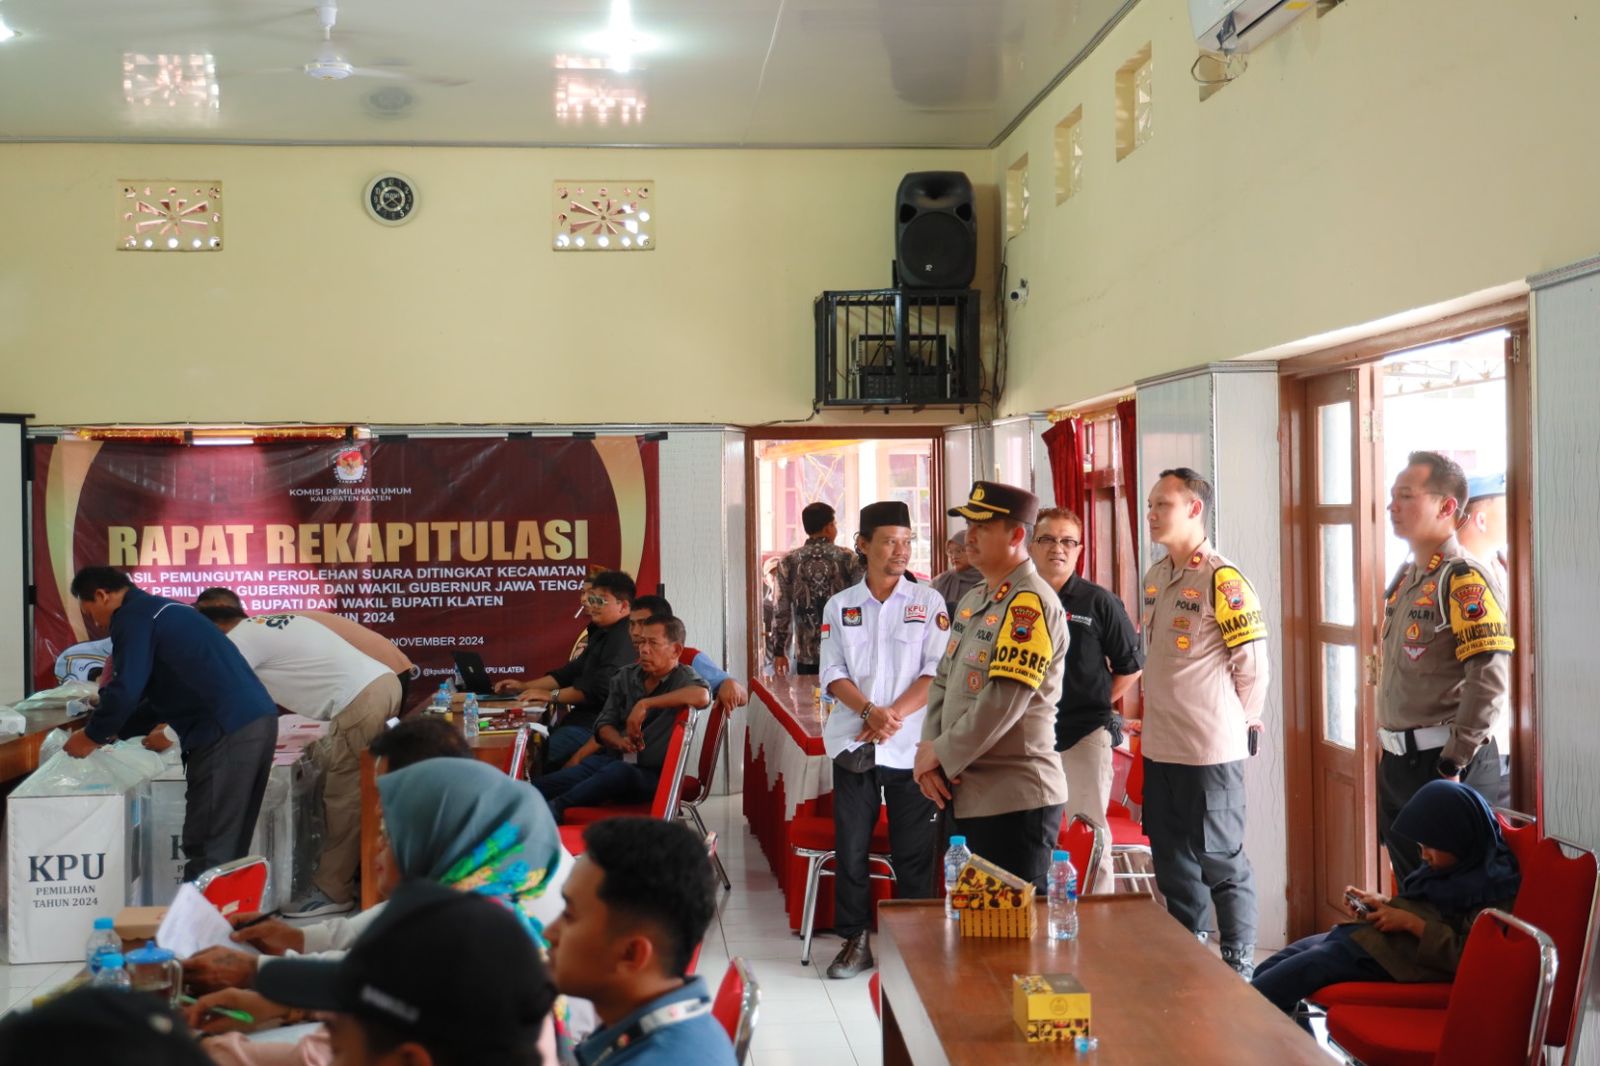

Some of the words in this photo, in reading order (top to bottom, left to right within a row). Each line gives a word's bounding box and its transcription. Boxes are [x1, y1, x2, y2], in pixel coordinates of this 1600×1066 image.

[289, 488, 323, 496] KOMISI
[107, 524, 254, 567] RAPAT
[267, 520, 588, 565] REKAPITULASI
[160, 571, 264, 583] PEMUNGUTAN
[268, 570, 358, 582] PEROLEHAN
[362, 568, 414, 580] SUARA
[417, 566, 494, 579] DITINGKAT
[498, 565, 586, 578] KECAMATAN
[239, 584, 320, 596] GUBERNUR
[324, 583, 354, 595] DAN
[359, 582, 406, 594] WAKIL
[408, 580, 492, 593] GUBERNUR
[496, 580, 536, 592] JAWA
[540, 579, 586, 592] TENGA
[252, 600, 302, 611] BUPATI
[306, 599, 338, 610] DAN
[342, 598, 388, 609] WAKIL
[392, 596, 442, 608] BUPATI
[448, 596, 504, 607] KLATEN
[1175, 600, 1200, 612] POLRI
[363, 612, 395, 624] 2024
[1408, 610, 1434, 621] POLRI
[390, 636, 456, 647] NOVEMBER
[459, 636, 484, 646] 2024
[976, 629, 994, 642] POLRI
[498, 666, 525, 674] KLATEN
[28, 852, 106, 883] KPU
[36, 884, 96, 896] PEMILIHAN
[32, 898, 70, 909] TAHUN
[72, 897, 98, 907] 2024
